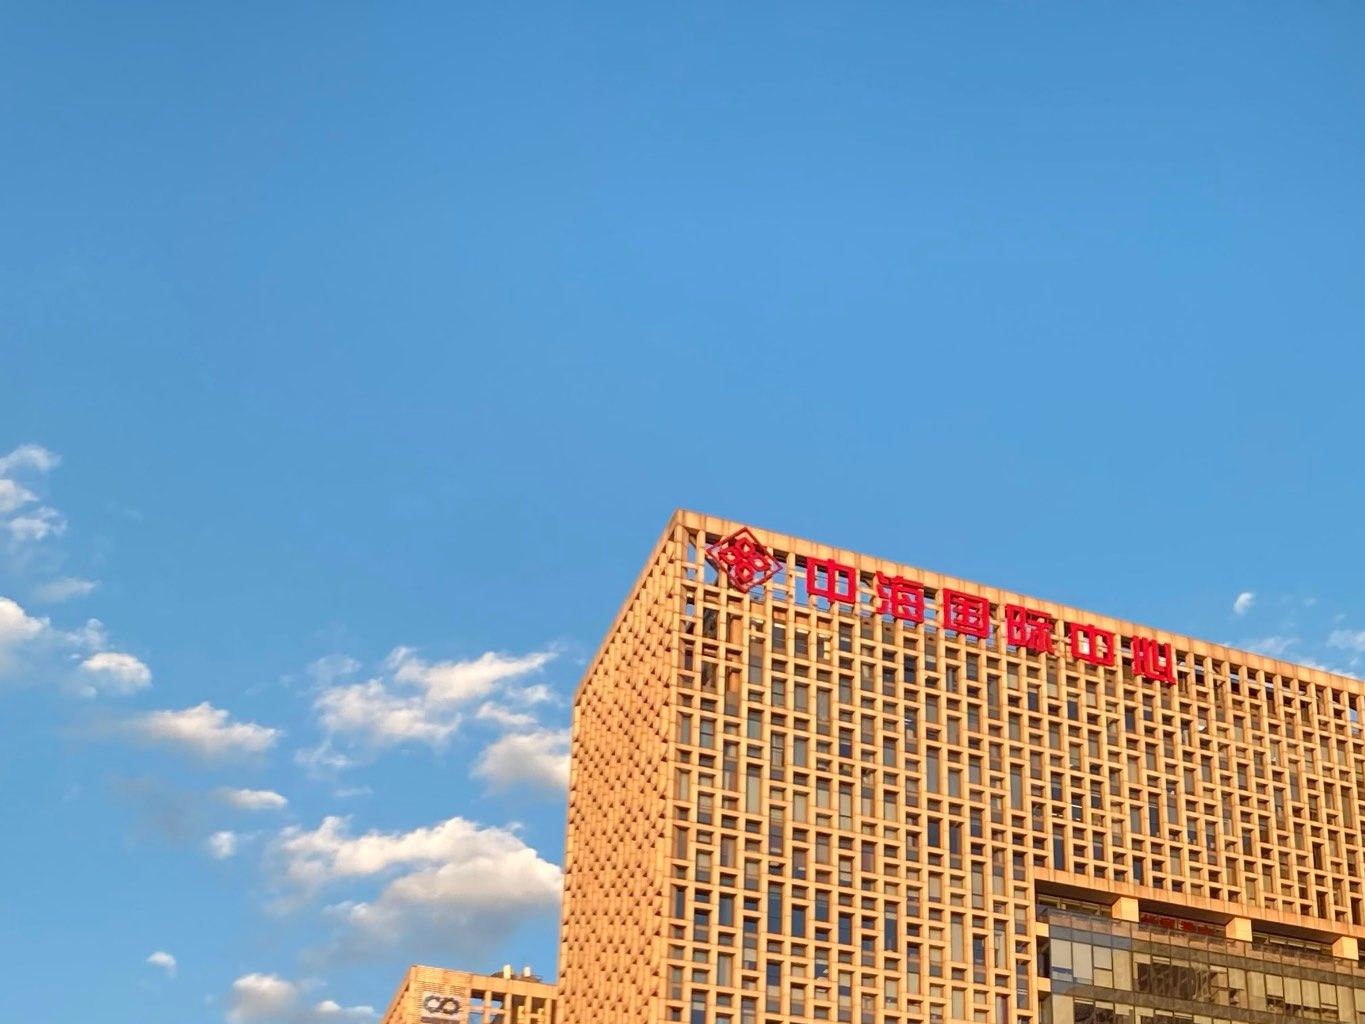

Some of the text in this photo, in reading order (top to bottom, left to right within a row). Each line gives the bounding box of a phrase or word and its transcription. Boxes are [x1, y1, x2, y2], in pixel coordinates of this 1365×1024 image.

[806, 556, 1176, 686] 中海国际中心
